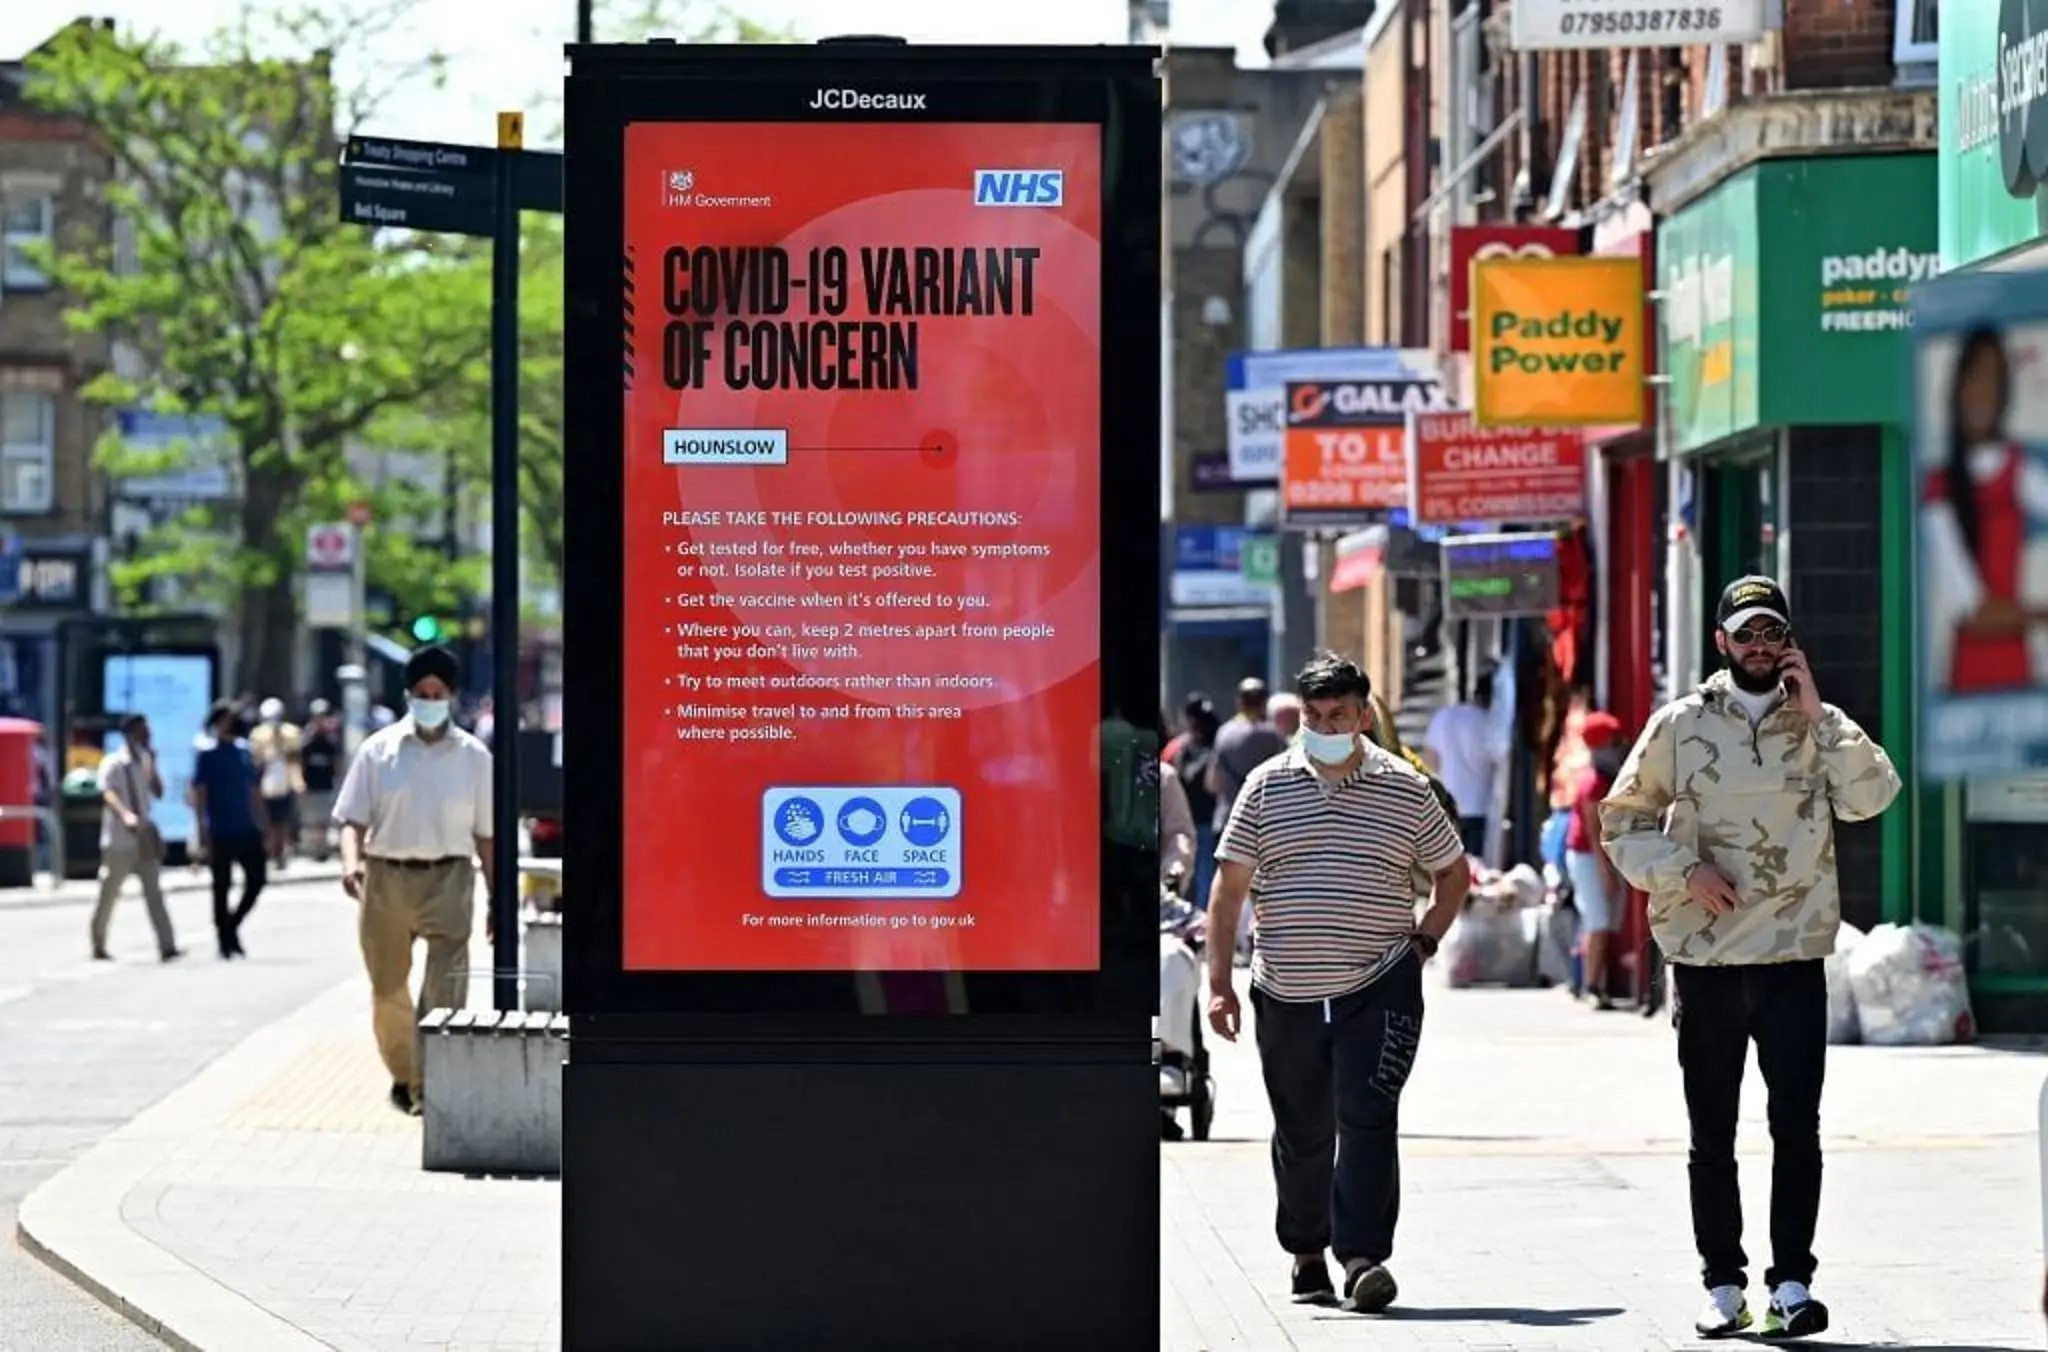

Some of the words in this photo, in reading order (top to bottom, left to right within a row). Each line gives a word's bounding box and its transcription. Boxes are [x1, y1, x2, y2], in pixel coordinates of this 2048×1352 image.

[1560, 8, 1722, 34] 07950387836
[809, 88, 927, 109] JCDecaux
[435, 148, 468, 167] Centre
[977, 172, 1062, 203] NHS
[669, 193, 692, 207] HM
[695, 193, 772, 207] Government
[663, 245, 848, 316] COVID-19
[859, 246, 1041, 316] VARIANT
[1490, 309, 1624, 345] Paddy
[663, 320, 715, 391] OF
[723, 320, 919, 391] CONCERN
[1490, 346, 1626, 374] Power
[674, 439, 776, 456] HOUNSLOW
[1315, 432, 1367, 462] TO
[1378, 432, 1406, 462] L
[1443, 440, 1557, 471] CHANGE
[662, 511, 721, 526] PLEASE
[725, 511, 767, 527] TAKE
[771, 511, 803, 526] THE
[807, 511, 904, 526] FOLLOWING
[906, 511, 1023, 527] PRECAUTIONS:
[676, 540, 705, 556] Get
[709, 540, 758, 556] tested
[762, 540, 785, 556] for
[789, 540, 824, 558] free,
[828, 540, 894, 557] whether
[897, 543, 929, 560] you
[930, 540, 968, 557] have
[970, 543, 1051, 559] symptoms
[676, 564, 695, 577] or
[698, 563, 729, 577] not.
[734, 561, 788, 577] Isolate
[789, 561, 802, 577] if
[804, 564, 834, 581] you
[837, 562, 868, 577] test
[871, 561, 937, 581] positive.
[677, 592, 706, 608] Get
[708, 592, 737, 608] the
[738, 591, 798, 608] vaccine
[799, 591, 843, 608] when
[846, 591, 872, 608] it's
[874, 591, 932, 608] offered
[935, 593, 954, 608] to
[956, 595, 991, 610] you.
[676, 621, 729, 638] Where
[730, 624, 762, 641] you
[764, 625, 797, 639] can,
[801, 623, 840, 641] keep
[843, 623, 854, 637] 2
[857, 623, 913, 638] metres
[915, 623, 957, 641] apart
[961, 621, 999, 638] from
[1001, 623, 1055, 641] people
[676, 643, 710, 659] that
[713, 645, 743, 661] you
[745, 642, 788, 660] don't
[791, 643, 819, 659] live
[823, 643, 862, 659] with.
[676, 673, 703, 692] Try
[704, 674, 724, 689] to
[726, 674, 767, 689] meet
[770, 672, 841, 689] outdoors
[844, 672, 894, 689] rather
[895, 672, 932, 689] than
[934, 672, 998, 690] indoors.
[676, 703, 748, 721] Minimise
[751, 703, 795, 720] travel
[799, 705, 817, 719] to
[819, 703, 850, 720] and
[853, 703, 893, 719] from
[895, 703, 926, 719] this
[927, 706, 962, 719] area
[676, 723, 726, 740] where
[727, 723, 798, 743] possible.
[773, 849, 825, 863] HANDS
[844, 849, 880, 863] FACE
[902, 849, 948, 863] SPACE
[825, 871, 869, 884] FRESH
[873, 871, 898, 884] AIR
[741, 913, 765, 927] For
[767, 915, 804, 927] more
[806, 913, 887, 927] information
[889, 916, 909, 929] go
[911, 914, 927, 927] to
[929, 913, 976, 929] gov.uk
